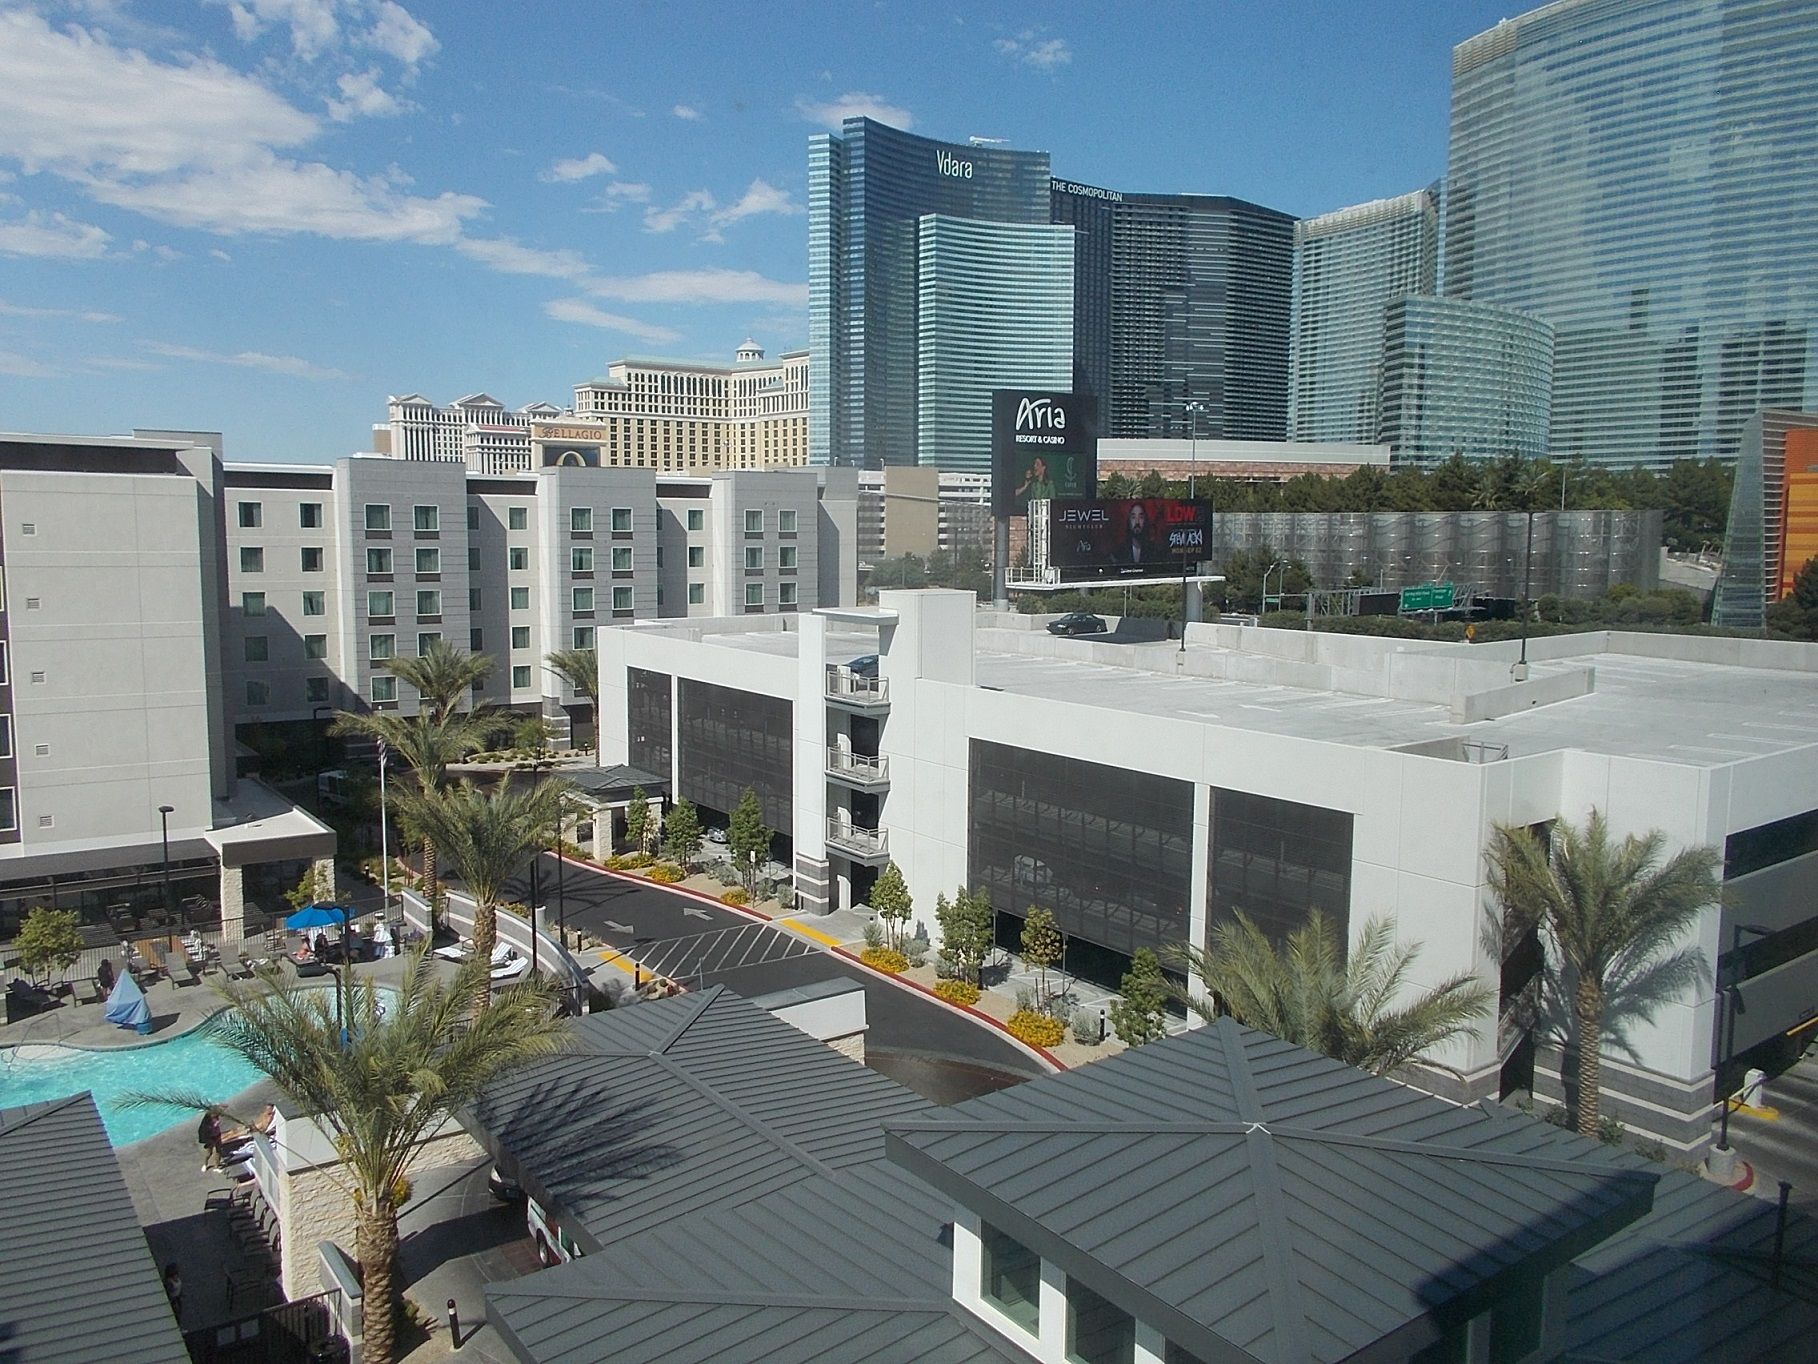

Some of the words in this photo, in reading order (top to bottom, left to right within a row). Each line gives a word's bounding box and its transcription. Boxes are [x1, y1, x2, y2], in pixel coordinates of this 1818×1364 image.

[937, 150, 972, 179] Vdara
[1052, 181, 1067, 192] THE
[1068, 185, 1123, 202] COSMOPOLITAN
[1015, 397, 1066, 430] Aria
[538, 426, 601, 440] BELLAGIO
[1015, 434, 1037, 443] RESORT
[1037, 435, 1043, 443] &
[1043, 435, 1065, 445] CASINO
[1058, 509, 1110, 522] JEWEL
